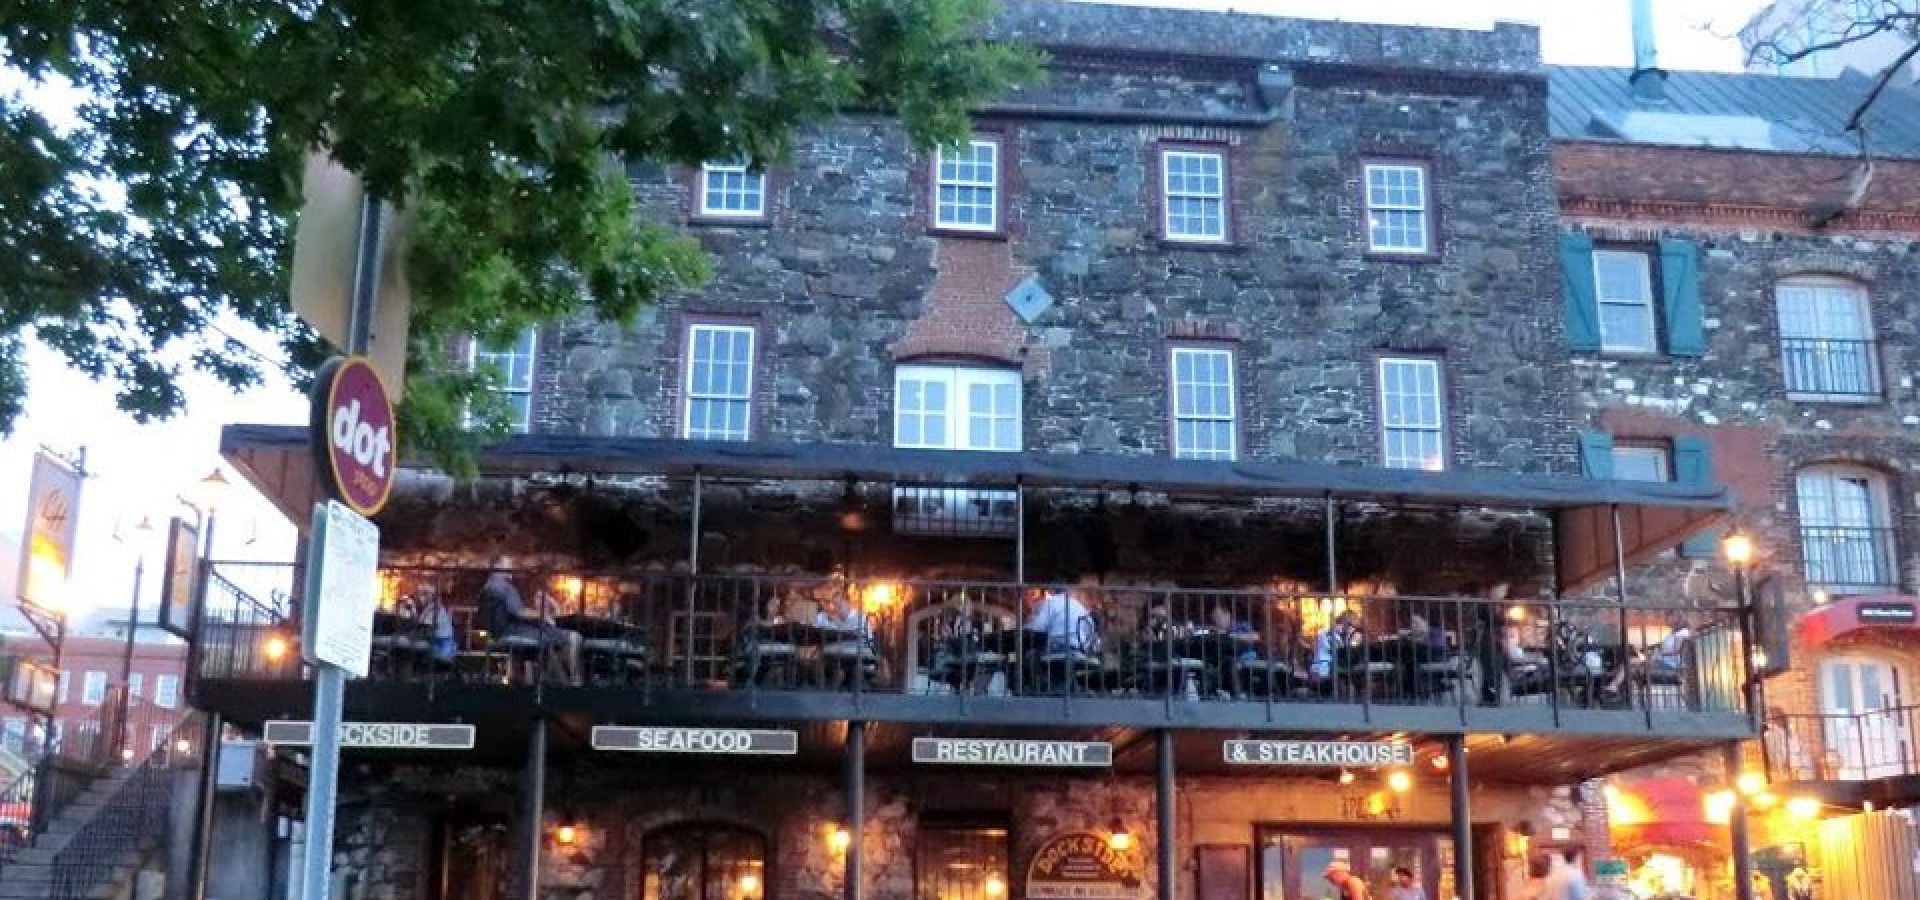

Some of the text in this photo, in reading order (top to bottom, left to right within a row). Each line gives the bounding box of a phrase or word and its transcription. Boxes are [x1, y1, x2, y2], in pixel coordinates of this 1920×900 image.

[334, 398, 391, 477] dot
[338, 724, 431, 746] CKSIDE
[639, 728, 752, 750] SEAFOOD
[937, 740, 1089, 763] RESTAURANT
[1233, 742, 1406, 764] & STEAKHOUSE
